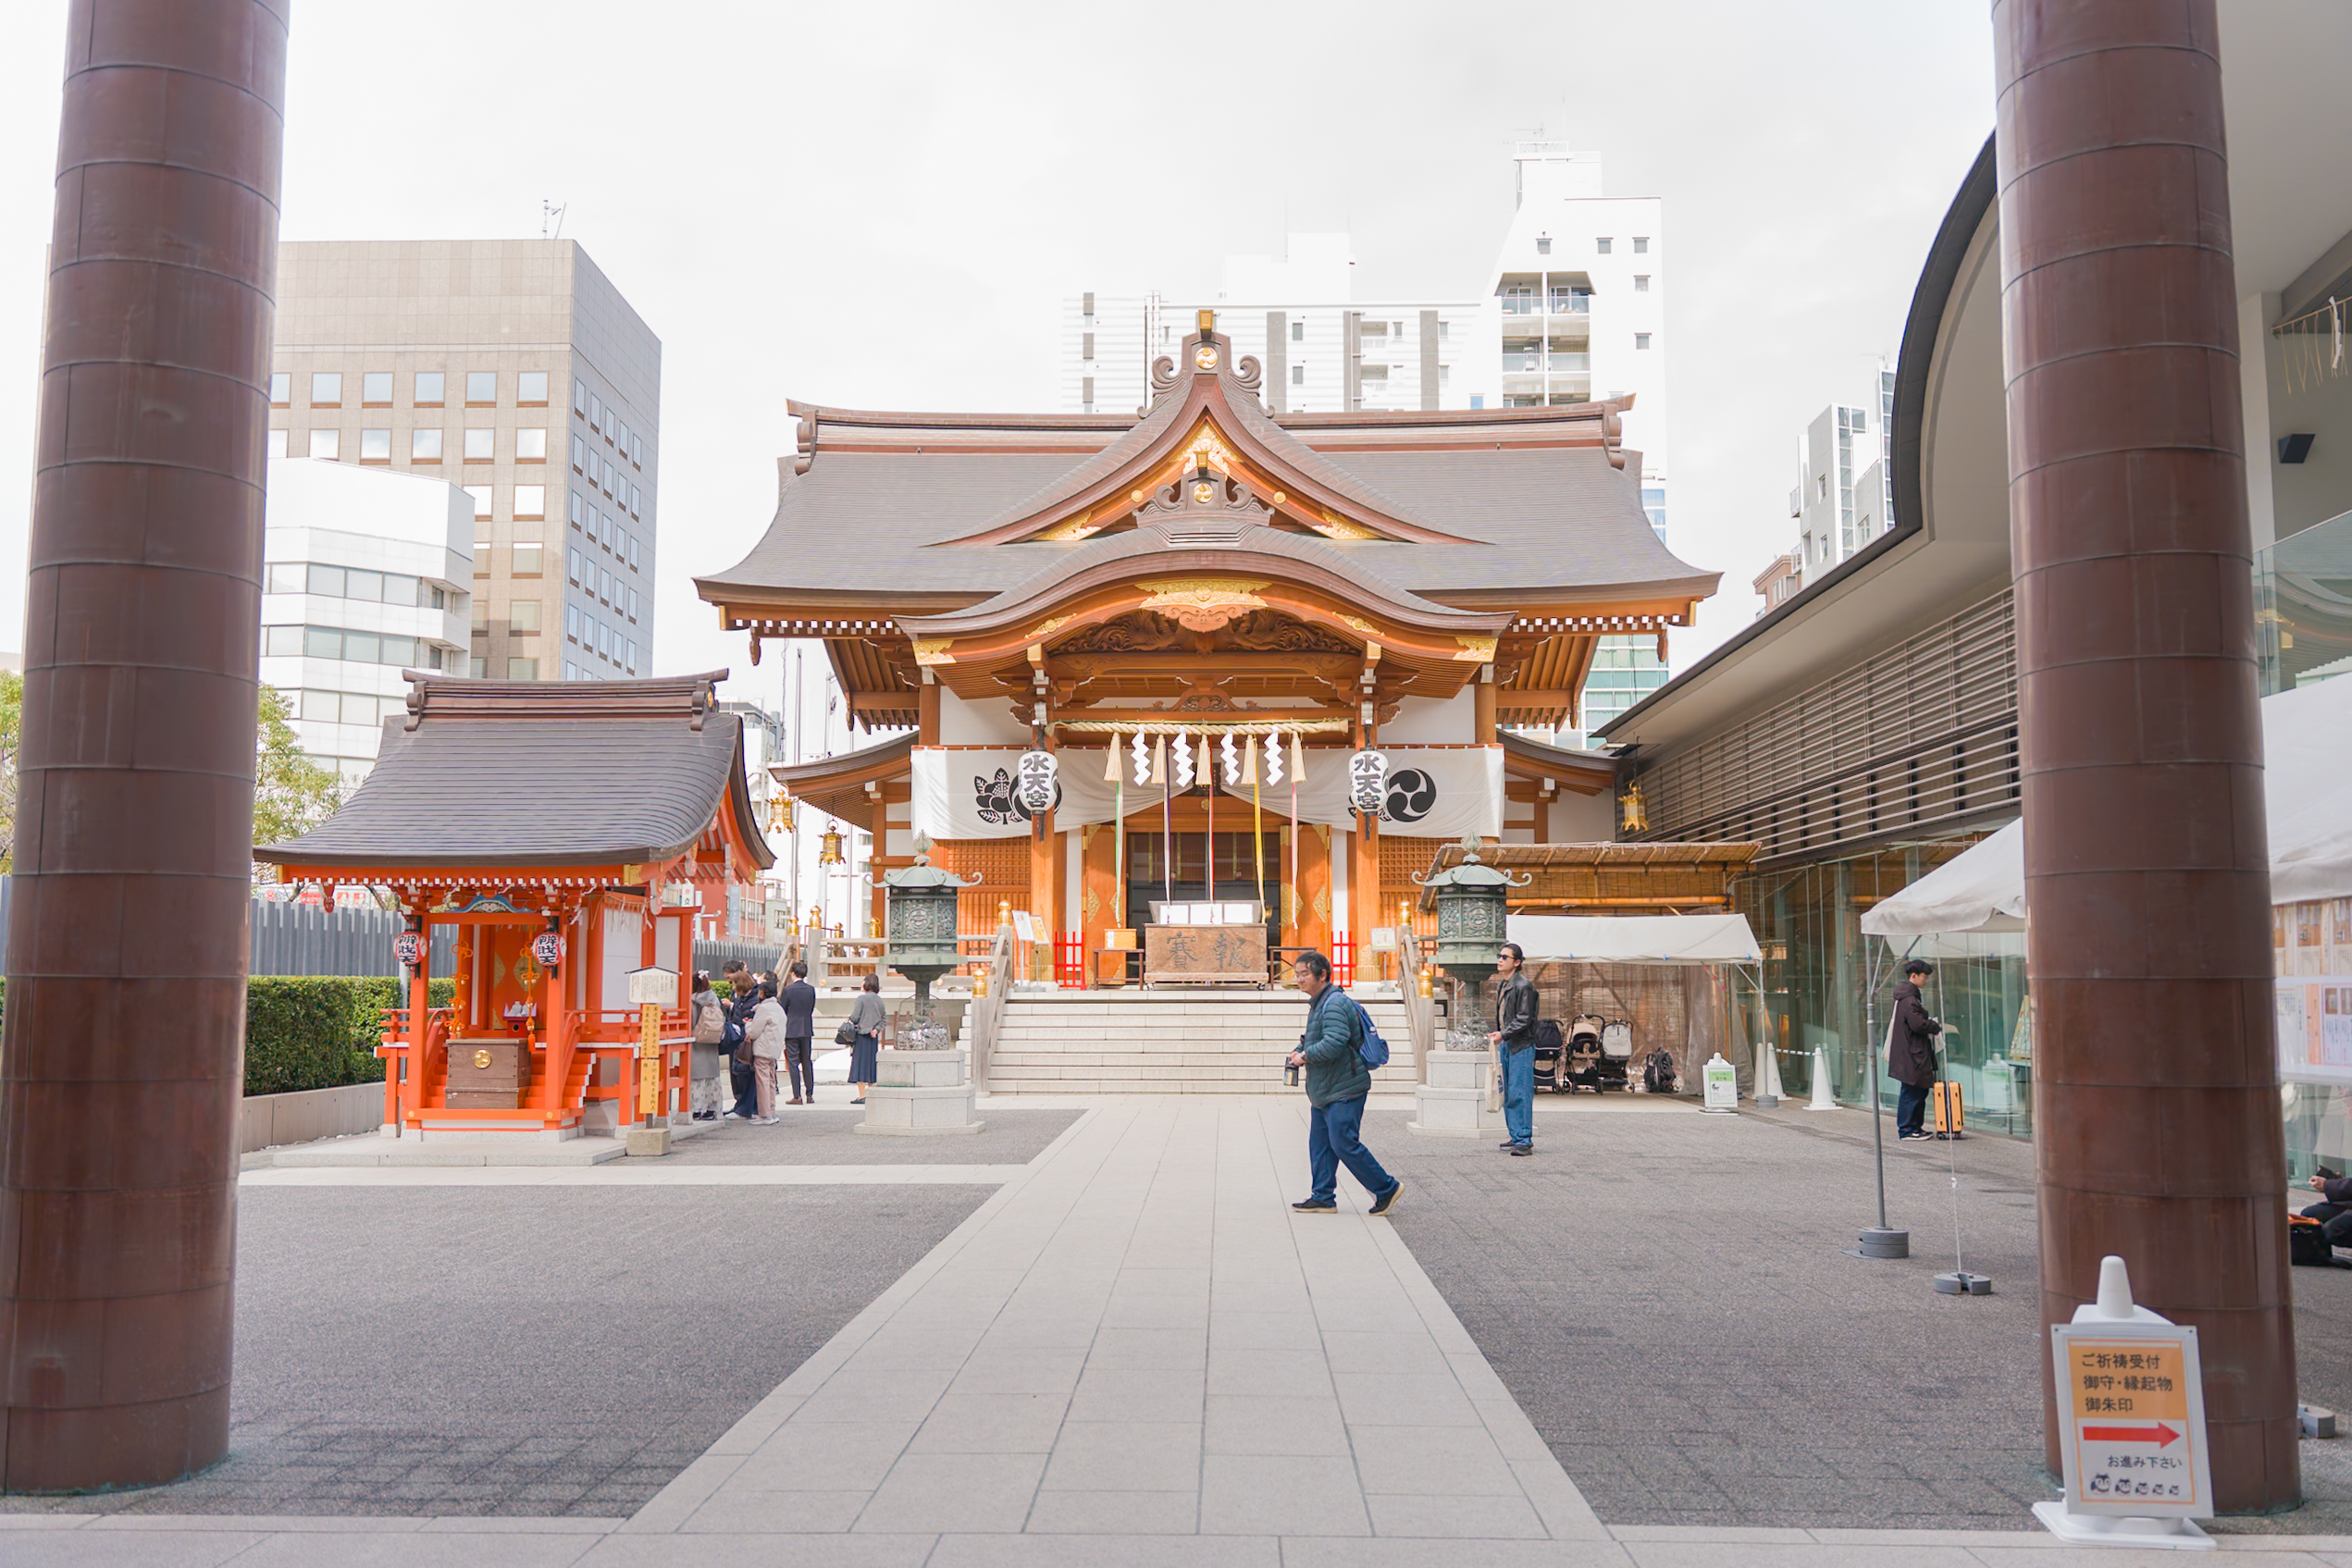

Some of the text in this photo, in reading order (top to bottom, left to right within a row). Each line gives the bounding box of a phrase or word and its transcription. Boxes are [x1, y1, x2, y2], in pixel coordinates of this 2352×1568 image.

[1022, 754, 1050, 809] 水天宮
[1354, 754, 1382, 809] 水天宮
[2082, 1352, 2161, 1370] ご祈祷受付
[2084, 1375, 2173, 1392] 御守・縁起物
[2085, 1396, 2134, 1413] 御朱印
[2107, 1455, 2183, 1470] お進み下さい
